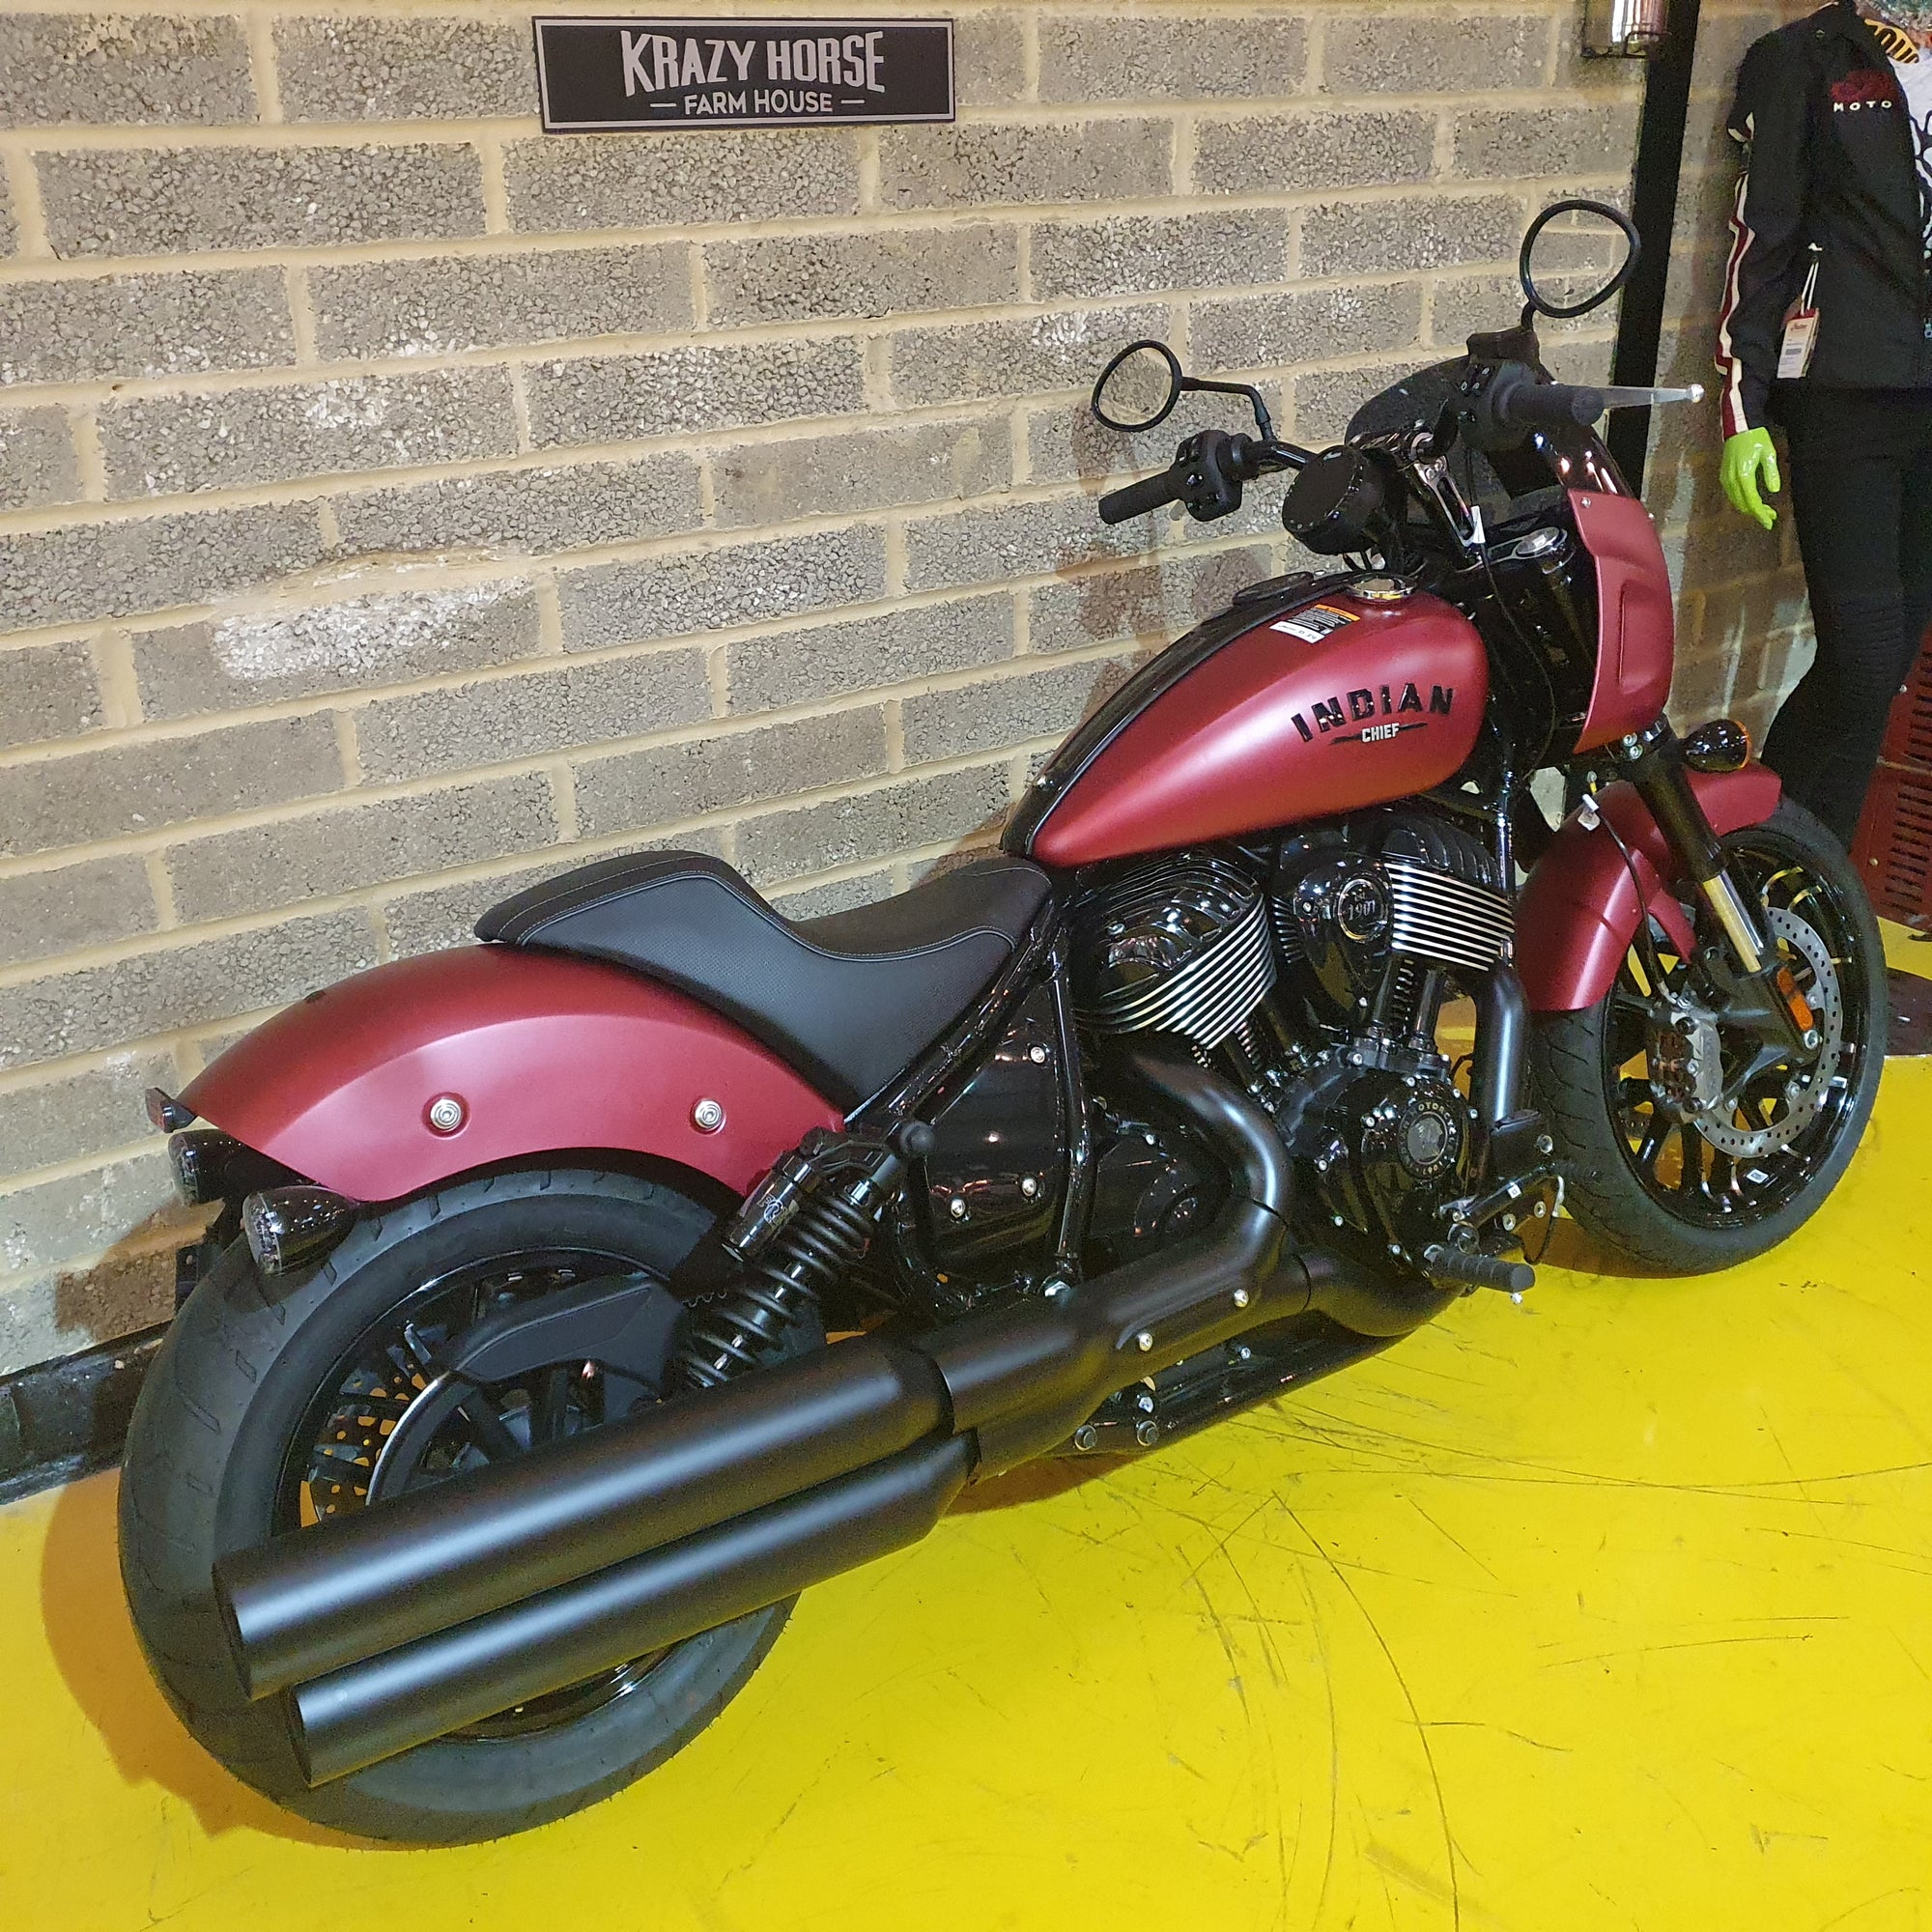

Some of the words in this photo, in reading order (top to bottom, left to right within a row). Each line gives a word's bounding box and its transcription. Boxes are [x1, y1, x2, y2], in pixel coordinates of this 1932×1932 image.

[620, 30, 755, 97] KRAZY
[767, 31, 885, 93] HORSE
[685, 91, 747, 115] FARM
[754, 89, 832, 113] HOUSE
[1833, 99, 1892, 112] MOTO
[1291, 682, 1453, 742] INDIAN
[1362, 723, 1400, 743] CHIEF
